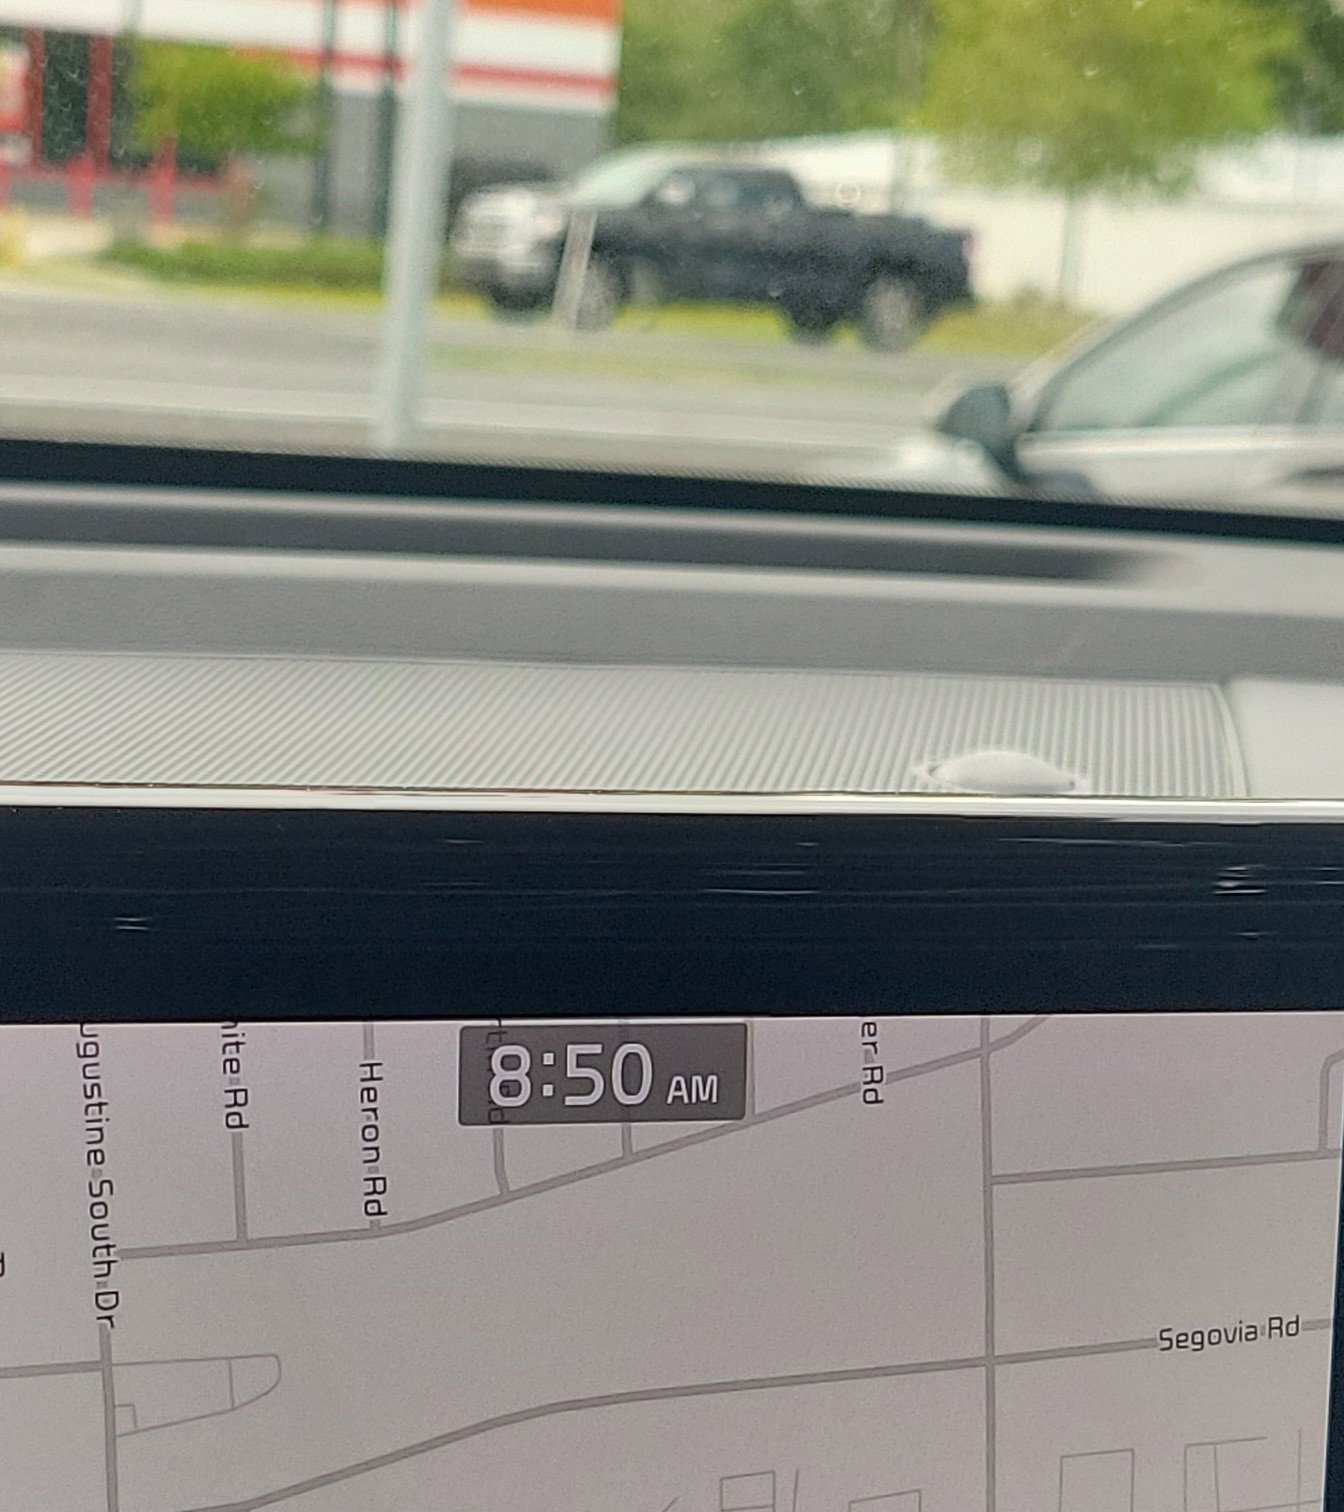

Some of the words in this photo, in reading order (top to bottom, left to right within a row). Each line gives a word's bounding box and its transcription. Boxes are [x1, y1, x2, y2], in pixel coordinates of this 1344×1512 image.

[489, 1042, 654, 1108] 8:50
[666, 1074, 718, 1104] AM
[862, 1065, 885, 1105] Rd
[223, 1088, 250, 1130] Rd
[359, 1062, 384, 1164] Heron
[362, 1176, 388, 1217] Rd
[88, 1179, 119, 1279] South
[94, 1290, 120, 1329] Dr
[1159, 1319, 1258, 1352] Segovia
[1268, 1314, 1300, 1340] Rd
